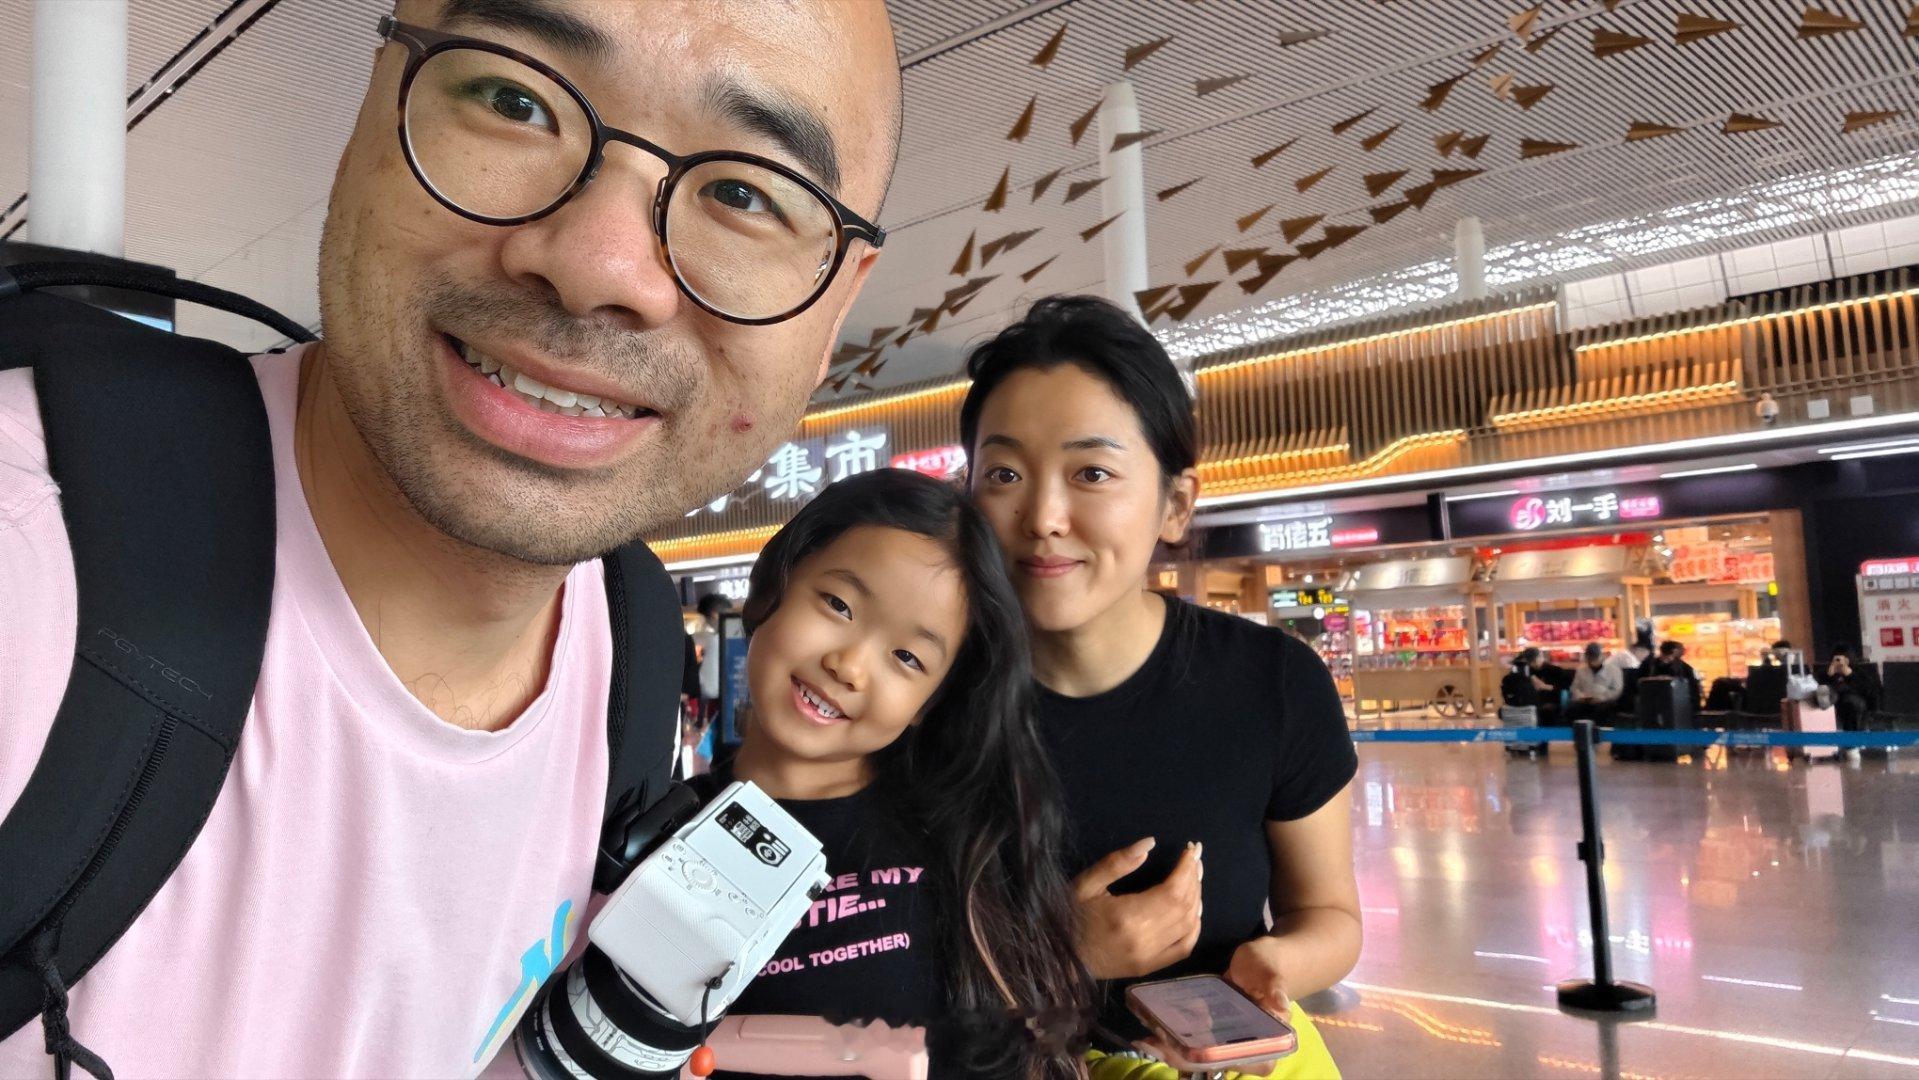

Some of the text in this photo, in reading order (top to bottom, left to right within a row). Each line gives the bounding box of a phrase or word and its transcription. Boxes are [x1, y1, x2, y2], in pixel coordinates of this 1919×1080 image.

[1545, 492, 1619, 524] 刘一手
[871, 867, 923, 884] MY
[794, 893, 887, 930] TIE...
[809, 932, 911, 967] TOGETHER)
